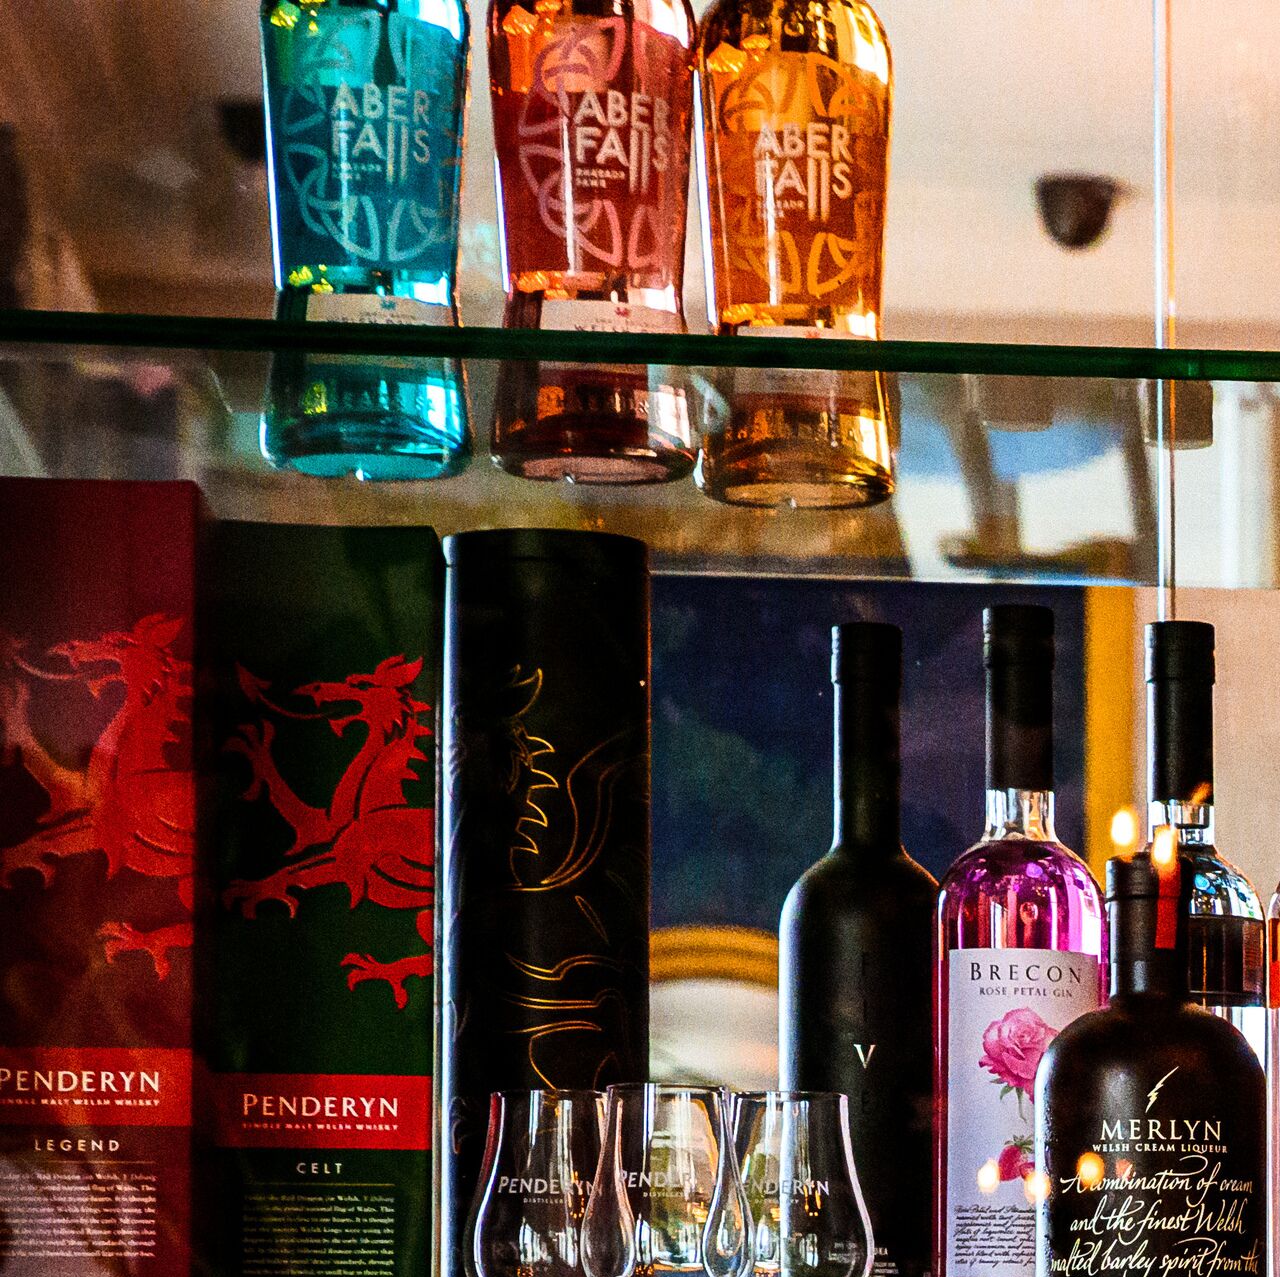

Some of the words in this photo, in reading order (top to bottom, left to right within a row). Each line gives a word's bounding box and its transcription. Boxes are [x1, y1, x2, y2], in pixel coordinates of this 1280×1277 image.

[332, 80, 430, 124] ABER
[573, 88, 670, 134] ABER
[753, 122, 853, 163] ABER
[970, 962, 1082, 985] BRECON
[980, 986, 1007, 996] ROSE
[1013, 987, 1048, 997] PETAL
[1053, 988, 1073, 998] GIN
[853, 1044, 876, 1069] V
[242, 1093, 398, 1118] PENDERYN
[34, 1138, 120, 1151] LEGEND
[1092, 1143, 1130, 1152] WELSH
[1135, 1143, 1176, 1152] CREAM
[1180, 1143, 1228, 1154] LIQUEUR
[1100, 1119, 1222, 1142] MERLYN
[296, 1162, 343, 1174] CELT
[1188, 1162, 1222, 1207] of
[1219, 1177, 1253, 1194] cream
[1069, 1196, 1105, 1236] and
[1101, 1196, 1145, 1232] the
[1120, 1199, 1199, 1245] finest
[1194, 1196, 1248, 1235] Welsh
[1051, 1238, 1103, 1277] malted
[1240, 1238, 1259, 1275] the
